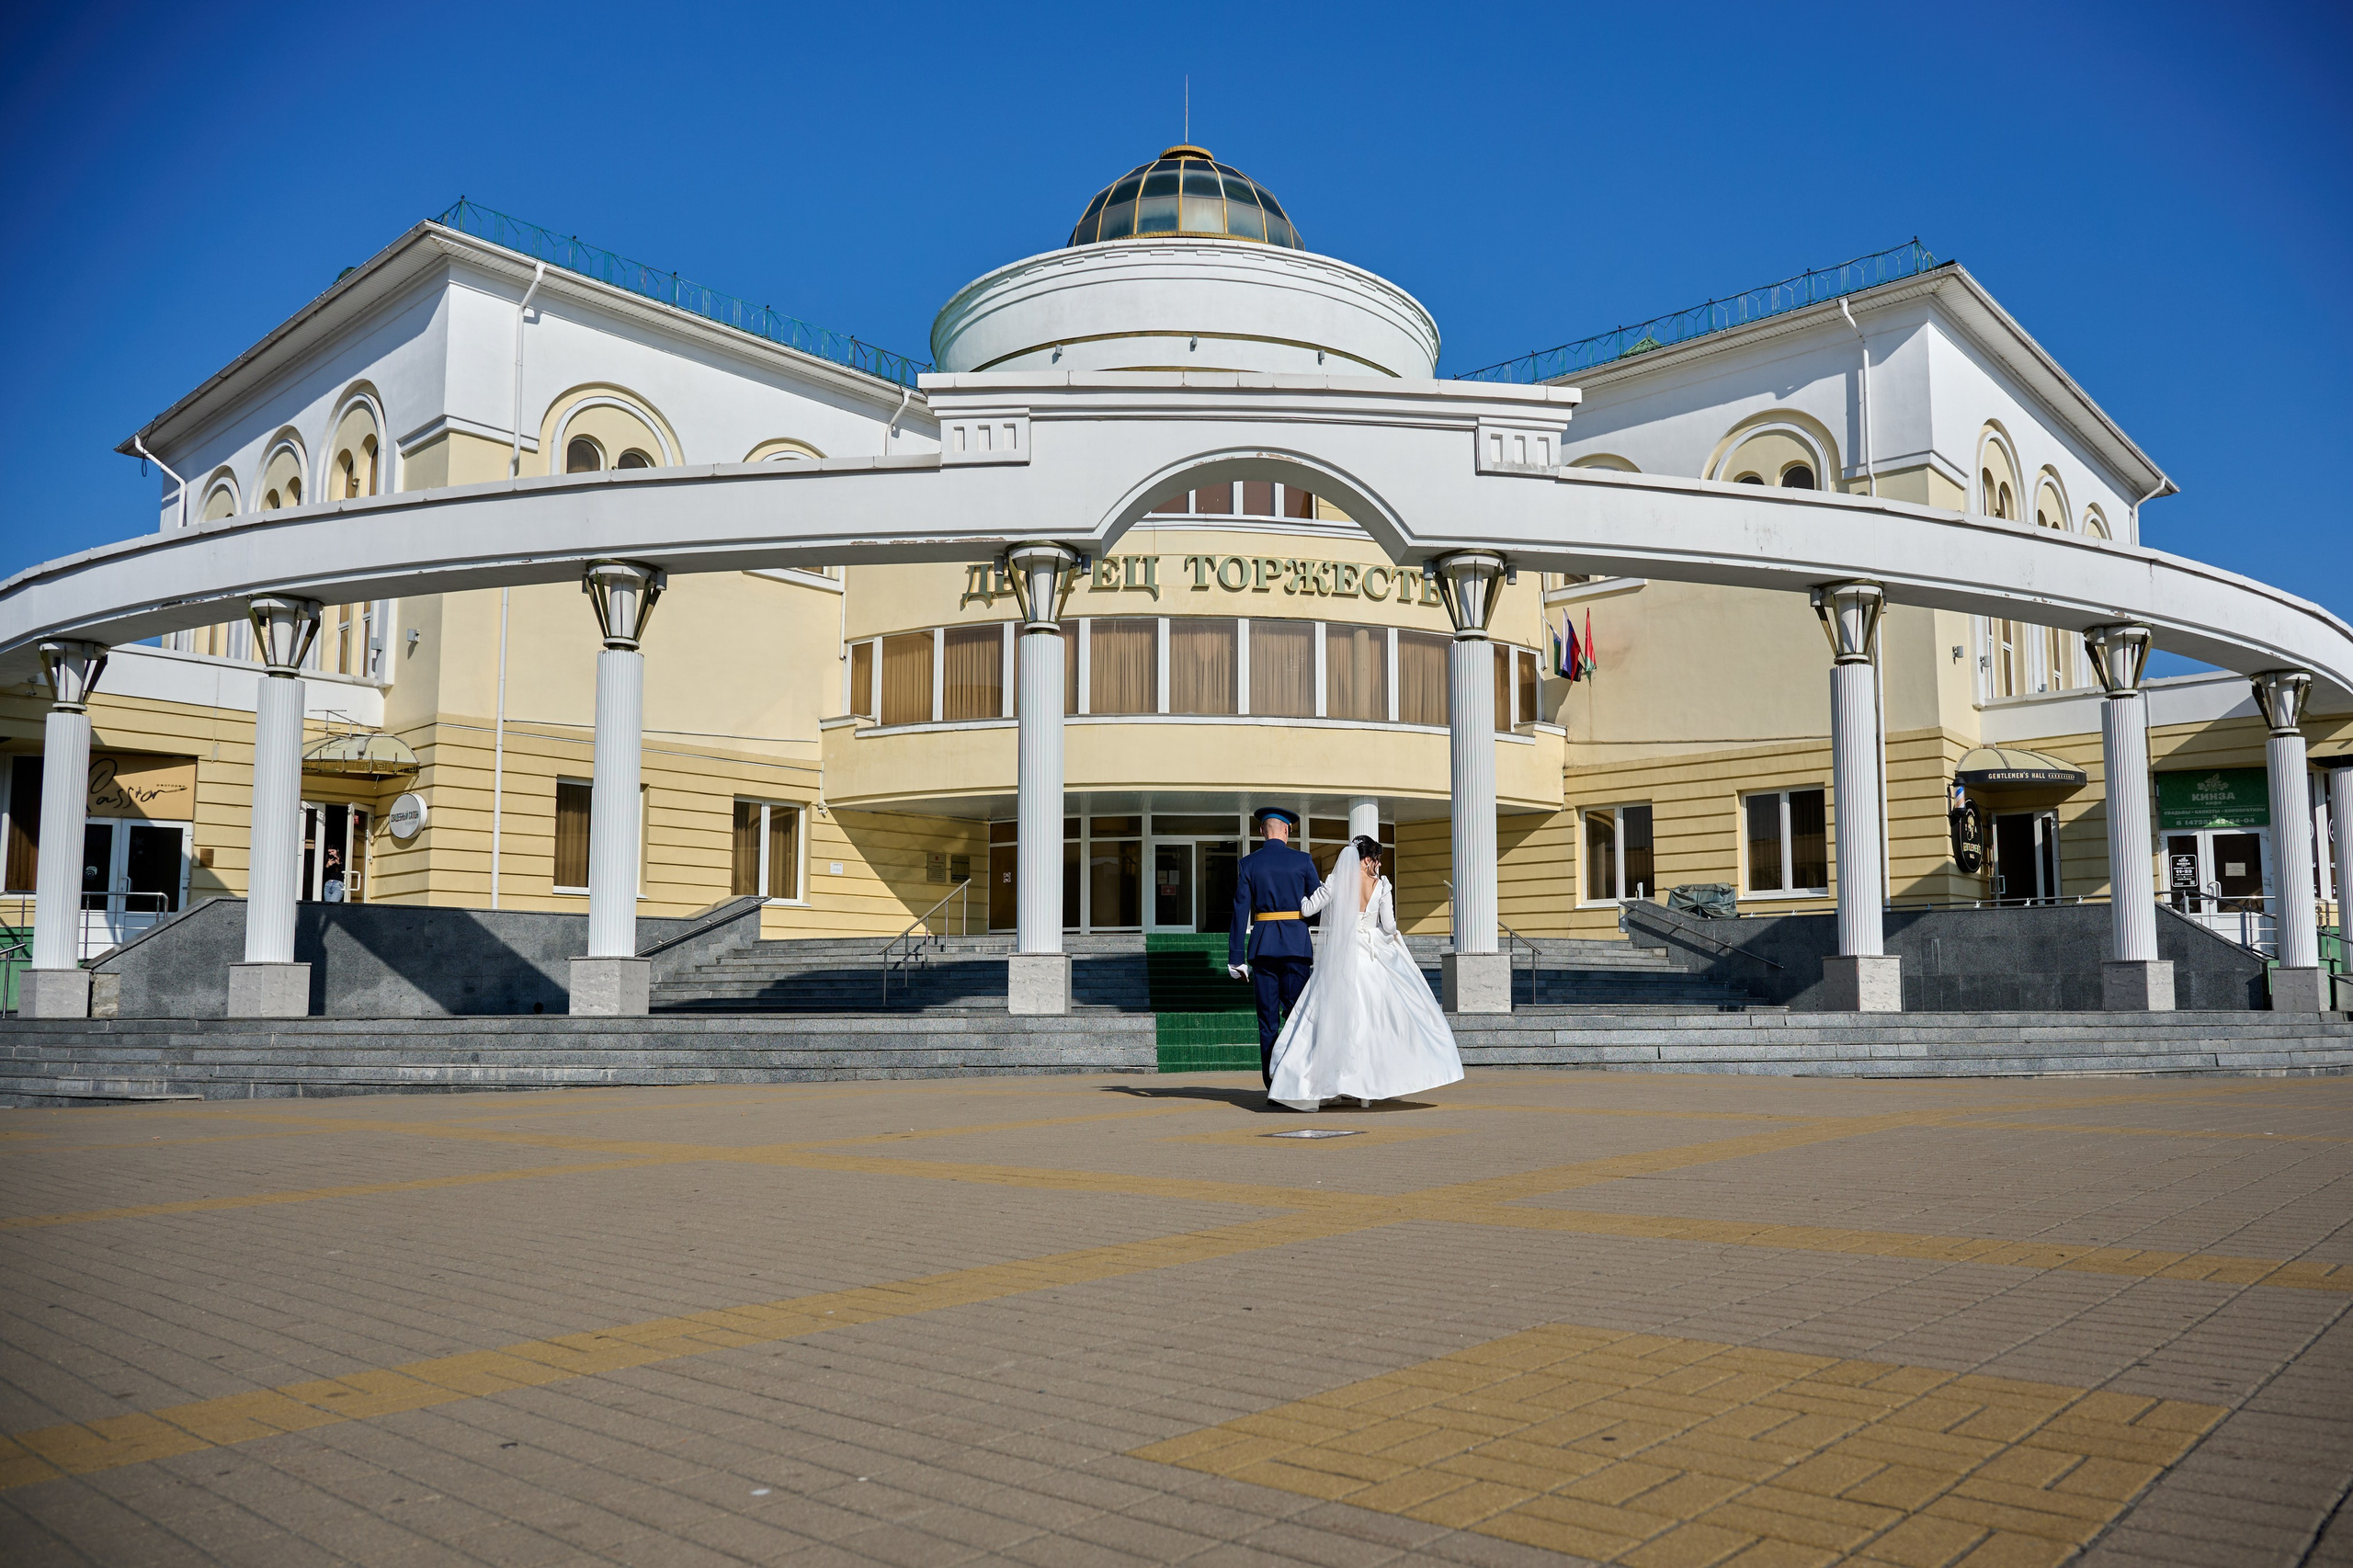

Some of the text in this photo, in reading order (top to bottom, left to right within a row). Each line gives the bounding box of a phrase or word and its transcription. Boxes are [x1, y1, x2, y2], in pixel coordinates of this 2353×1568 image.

[1184, 554, 1445, 607] ТОРЖЕСТВ
[1988, 771, 2029, 779] GENTLEMEN'S
[2191, 792, 2235, 801] КИНЗА
